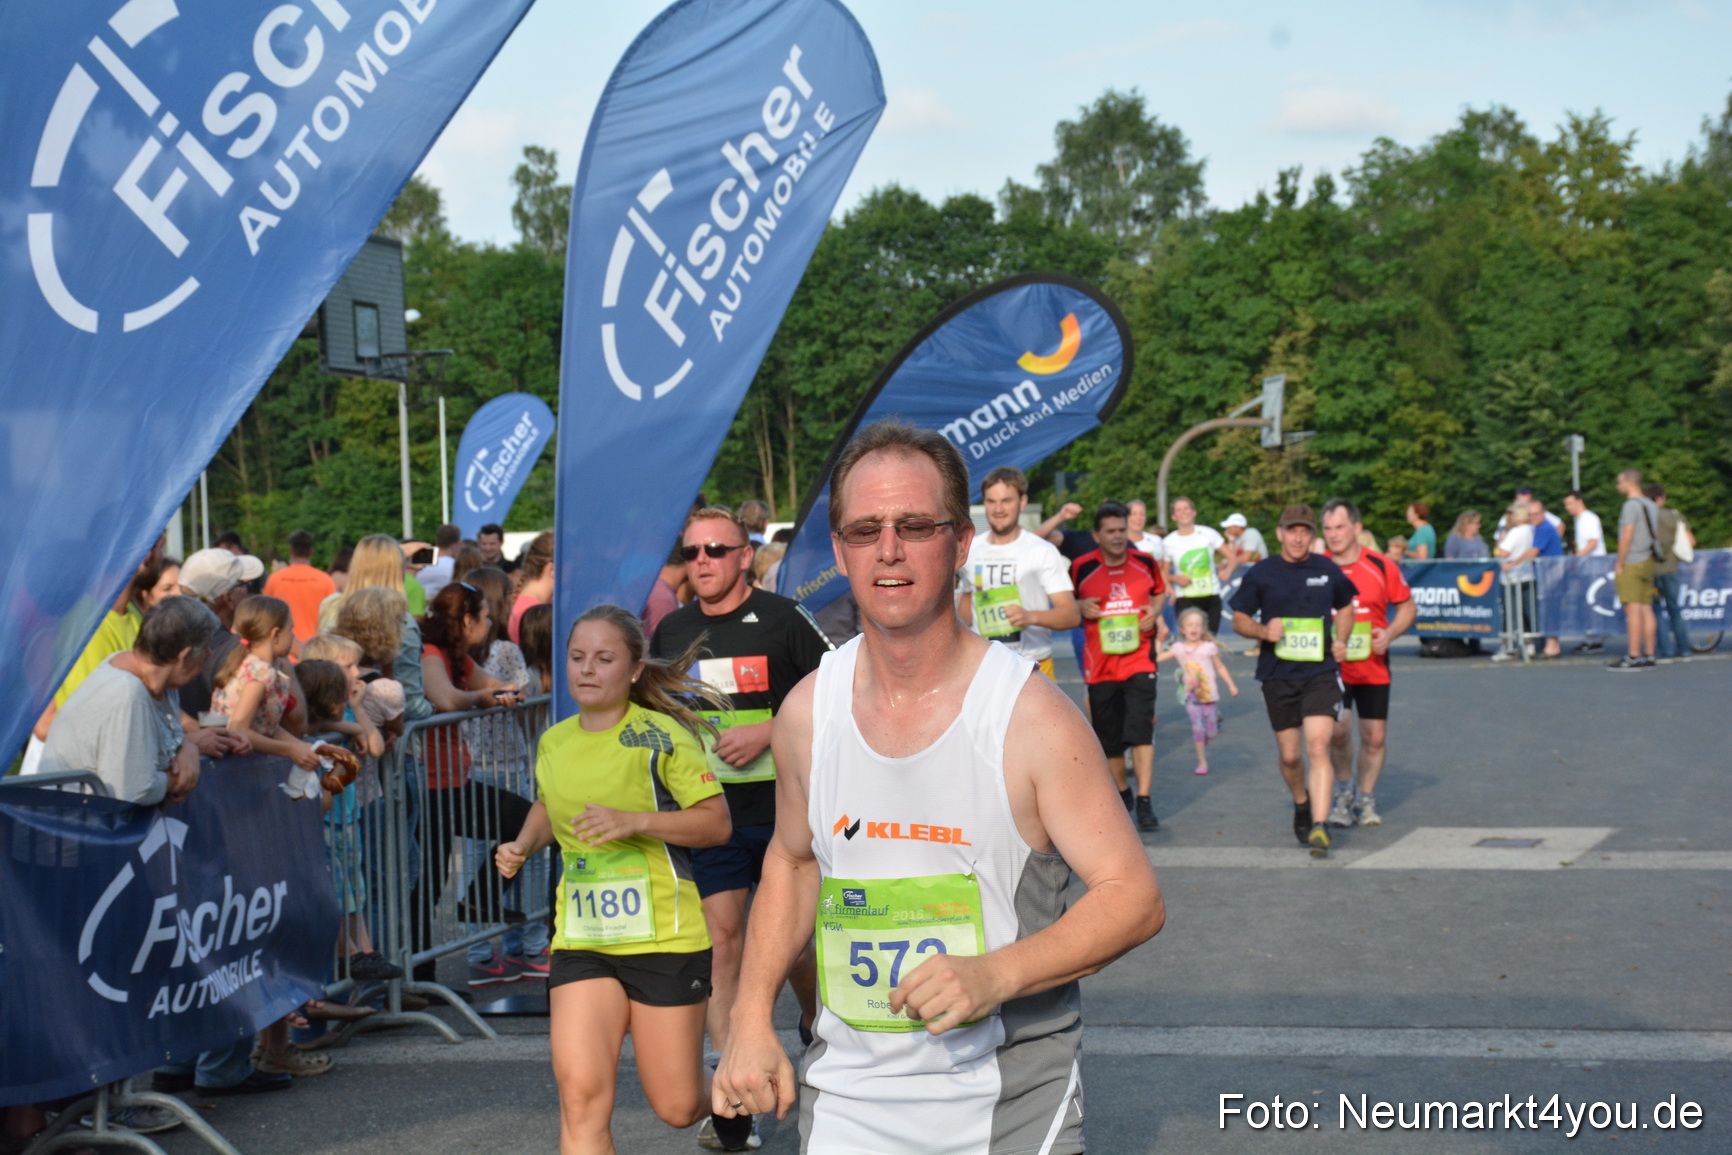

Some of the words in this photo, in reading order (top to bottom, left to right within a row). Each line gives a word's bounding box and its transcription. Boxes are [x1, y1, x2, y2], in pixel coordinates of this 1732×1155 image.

[643, 43, 813, 348] Fischer
[709, 101, 836, 343] AUTOMOBILE
[968, 421, 1020, 460] Druck
[1020, 402, 1055, 428] und
[1052, 364, 1113, 411] Medien
[478, 411, 533, 498] Fischer
[1107, 630, 1133, 644] 958
[1442, 605, 1461, 618] und
[1462, 605, 1493, 619] Medien
[1281, 634, 1319, 649] 1304
[867, 821, 972, 847] KLEBL
[131, 875, 287, 974] Fischer
[572, 887, 641, 918] 1180
[835, 904, 890, 916] firmenlauf
[148, 949, 263, 1019] AUTOMOBILE
